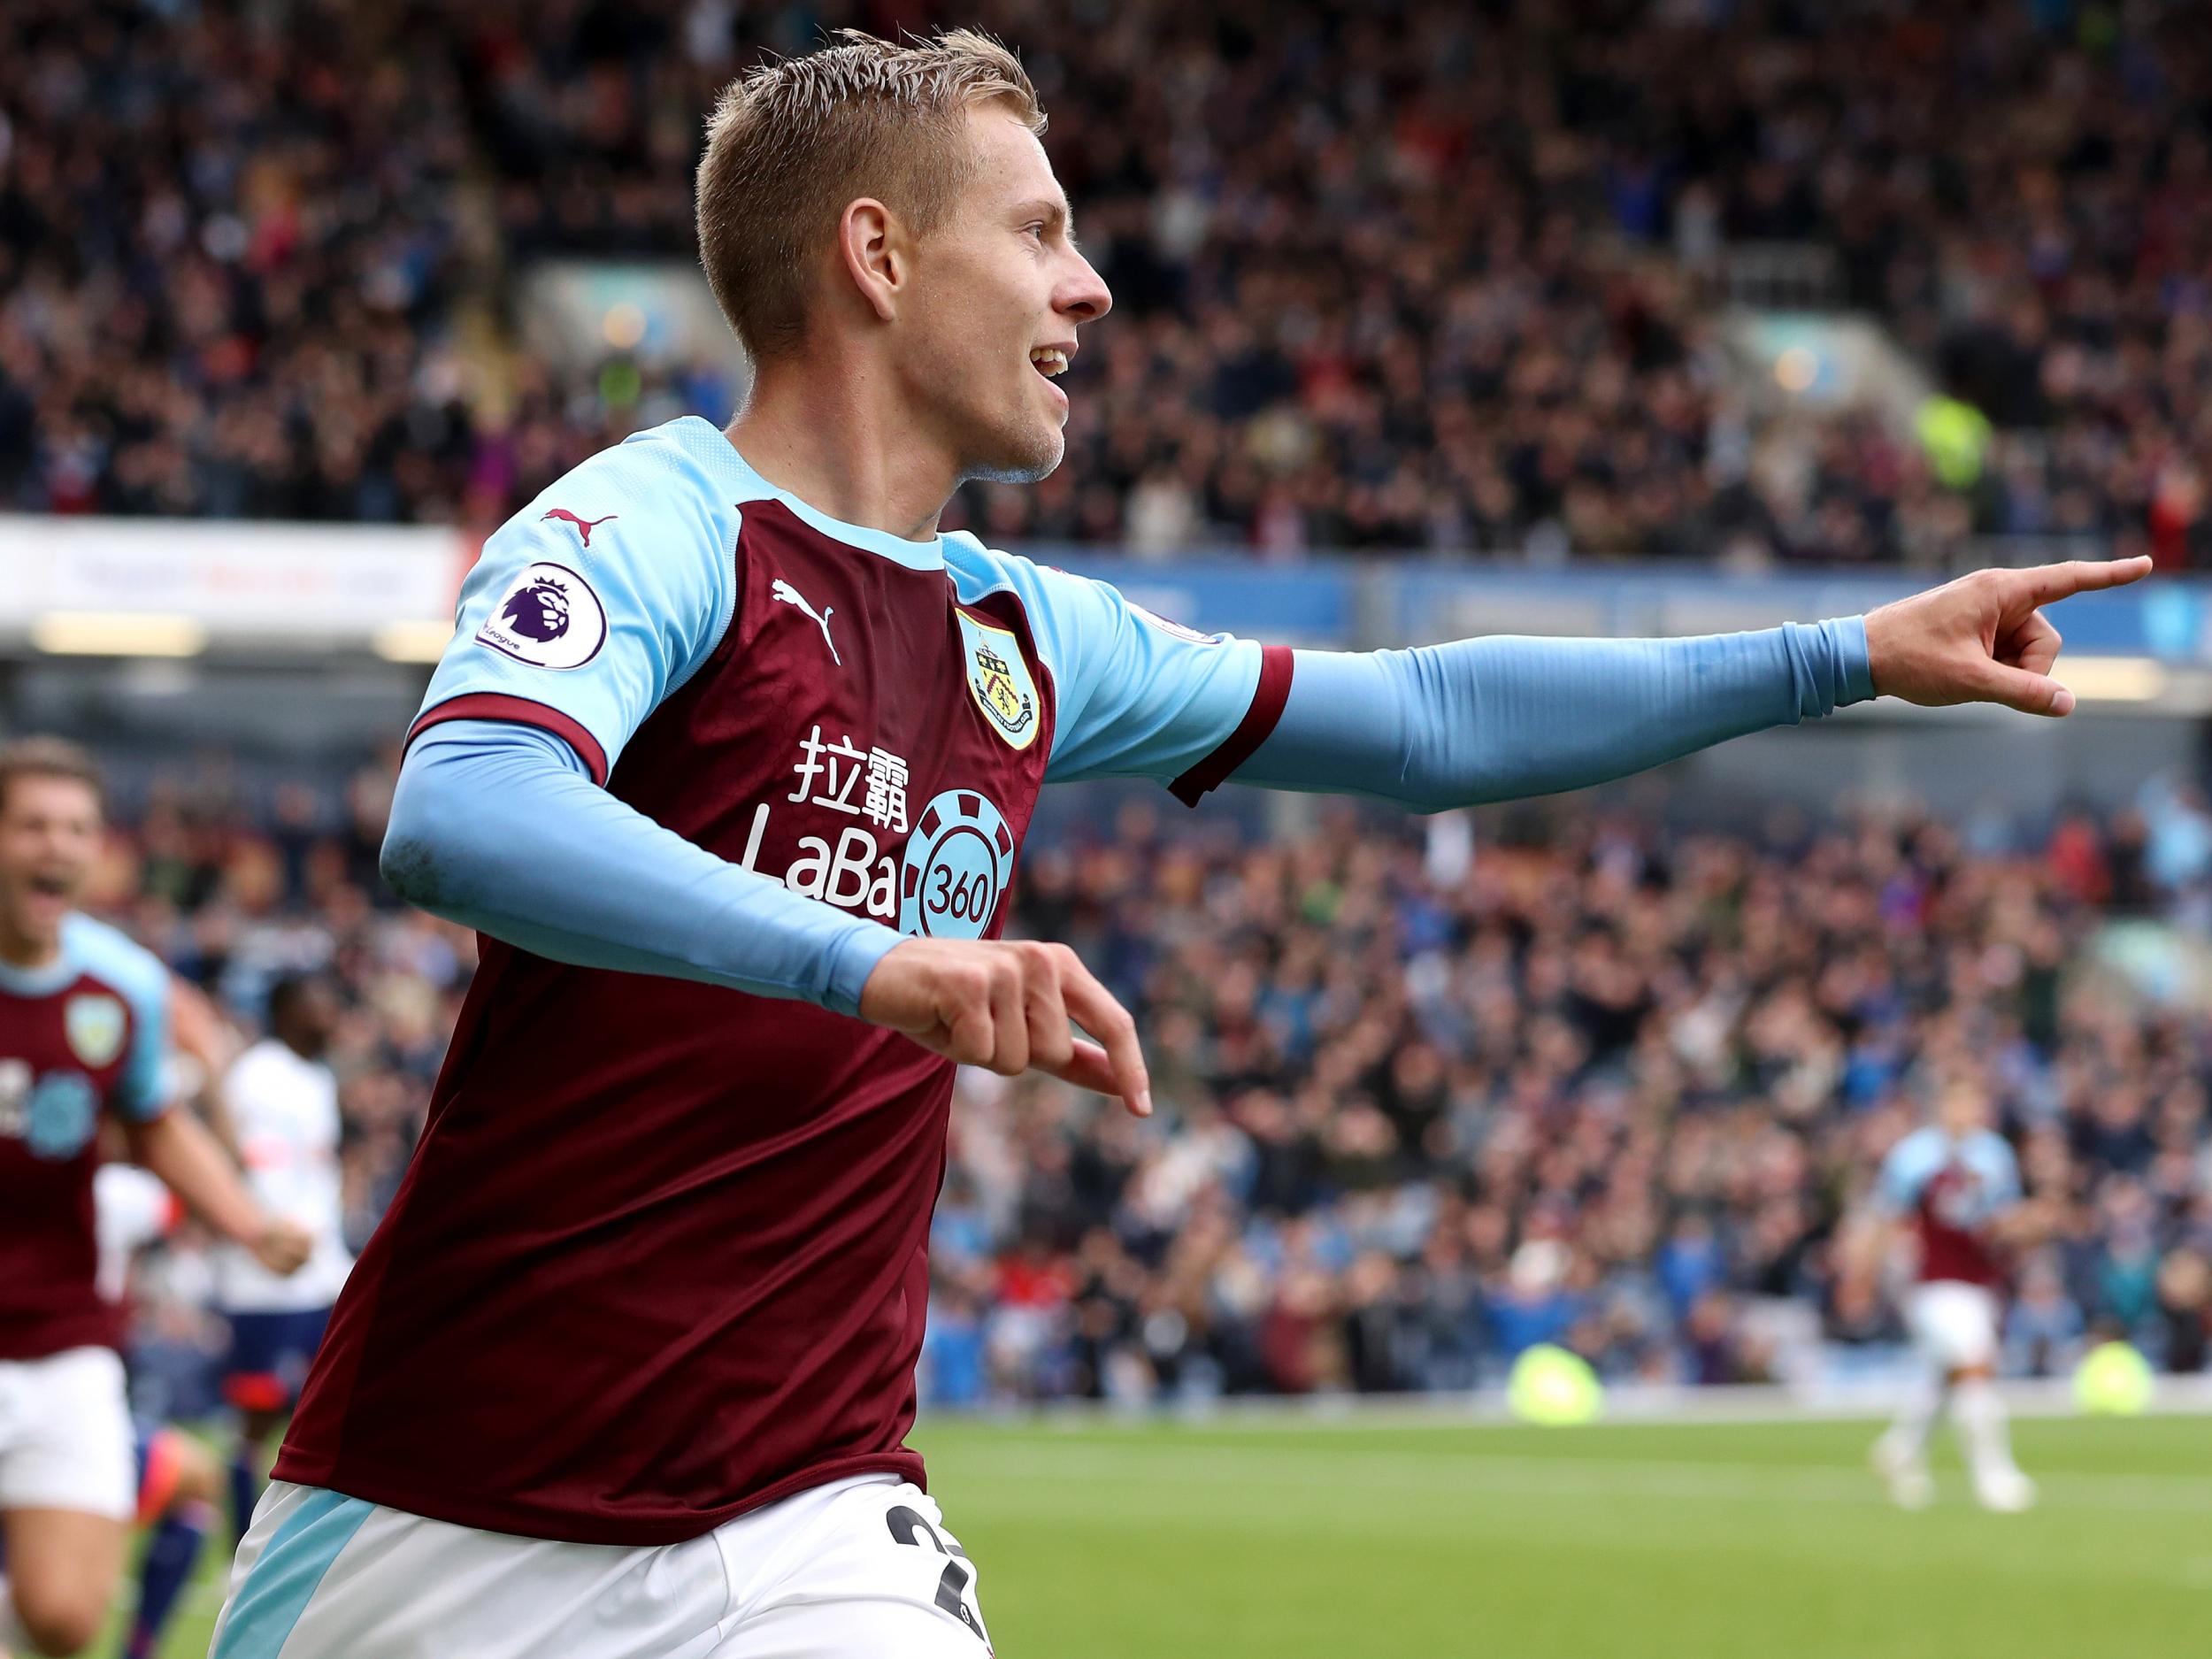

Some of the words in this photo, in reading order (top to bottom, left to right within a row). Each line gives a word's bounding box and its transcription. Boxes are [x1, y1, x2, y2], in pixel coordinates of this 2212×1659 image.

[787, 725, 909, 833] 拉霸
[741, 803, 896, 918] LaBa
[927, 864, 988, 923] 360
